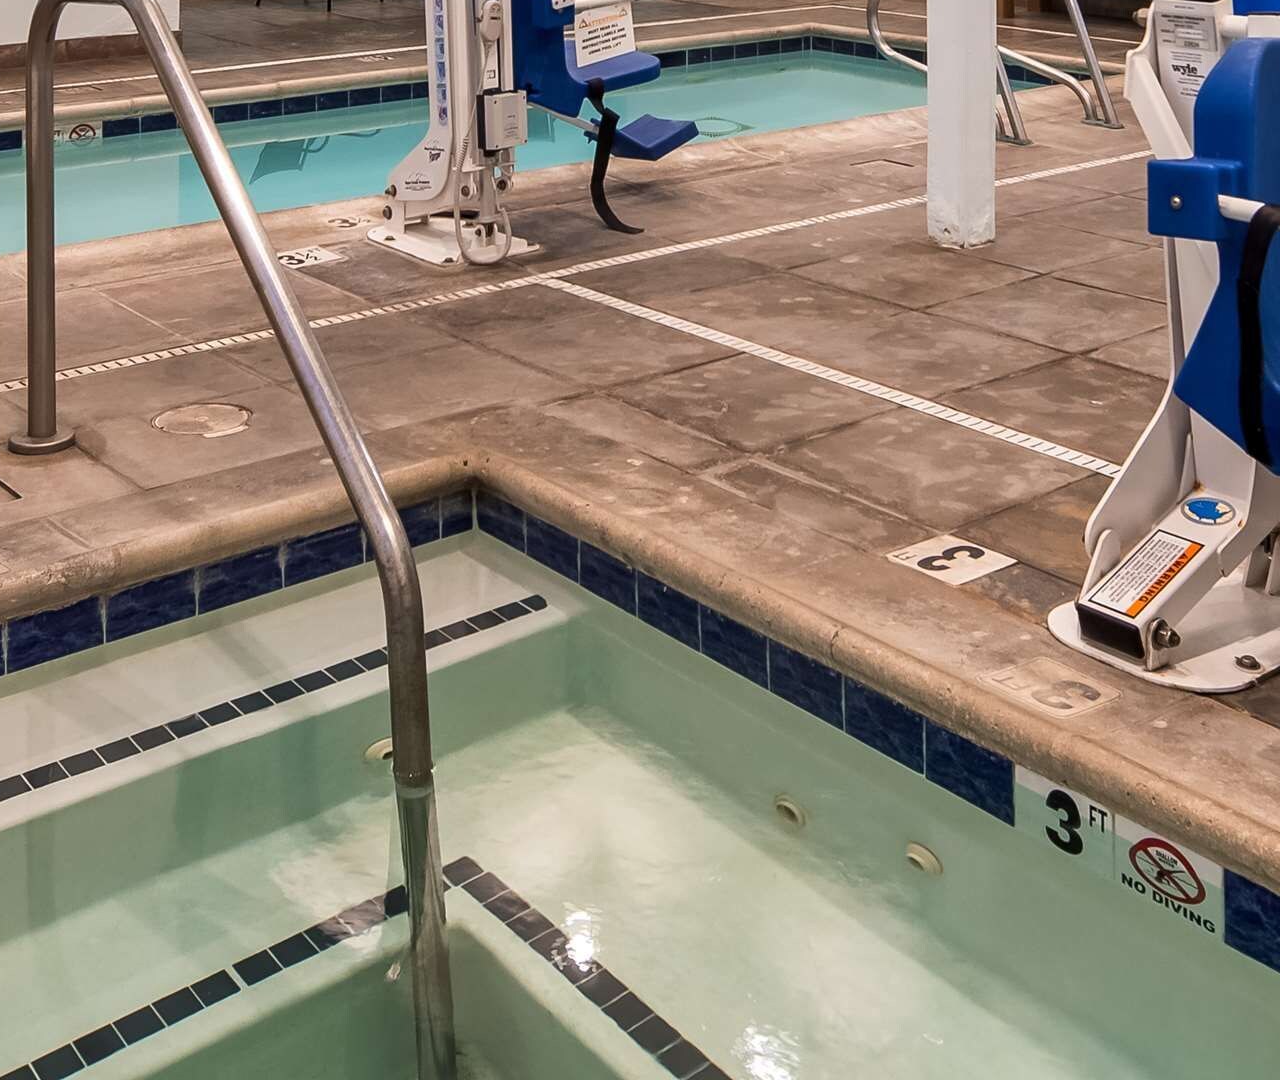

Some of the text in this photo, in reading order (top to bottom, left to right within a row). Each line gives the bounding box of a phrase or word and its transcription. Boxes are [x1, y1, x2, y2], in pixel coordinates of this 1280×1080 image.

[917, 545, 985, 571] 3
[1138, 556, 1183, 603] WARNING
[1031, 680, 1101, 709] 3
[1045, 789, 1108, 856] 3 FT
[1121, 872, 1216, 935] NO DIVING
